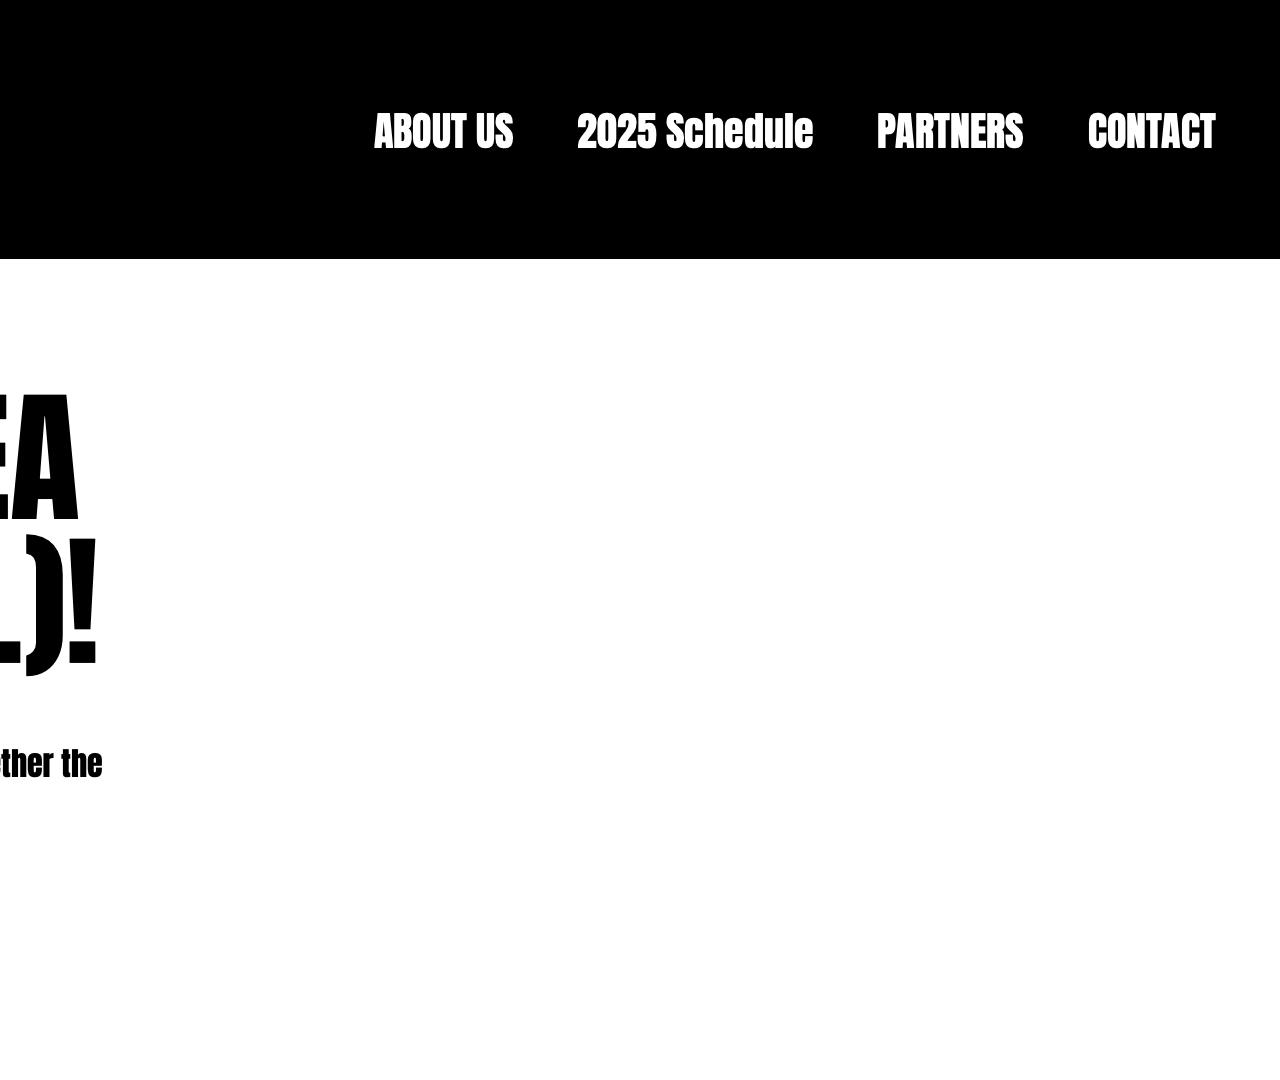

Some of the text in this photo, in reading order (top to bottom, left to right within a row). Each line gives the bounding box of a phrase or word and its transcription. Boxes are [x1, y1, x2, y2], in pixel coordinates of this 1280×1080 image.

[374, 113, 513, 148] ABOUT US
[578, 113, 813, 148] 2025 Schedule
[878, 113, 1023, 148] PARTNERS
[1089, 113, 1216, 148] CONTACT
[61, 749, 102, 777] the
